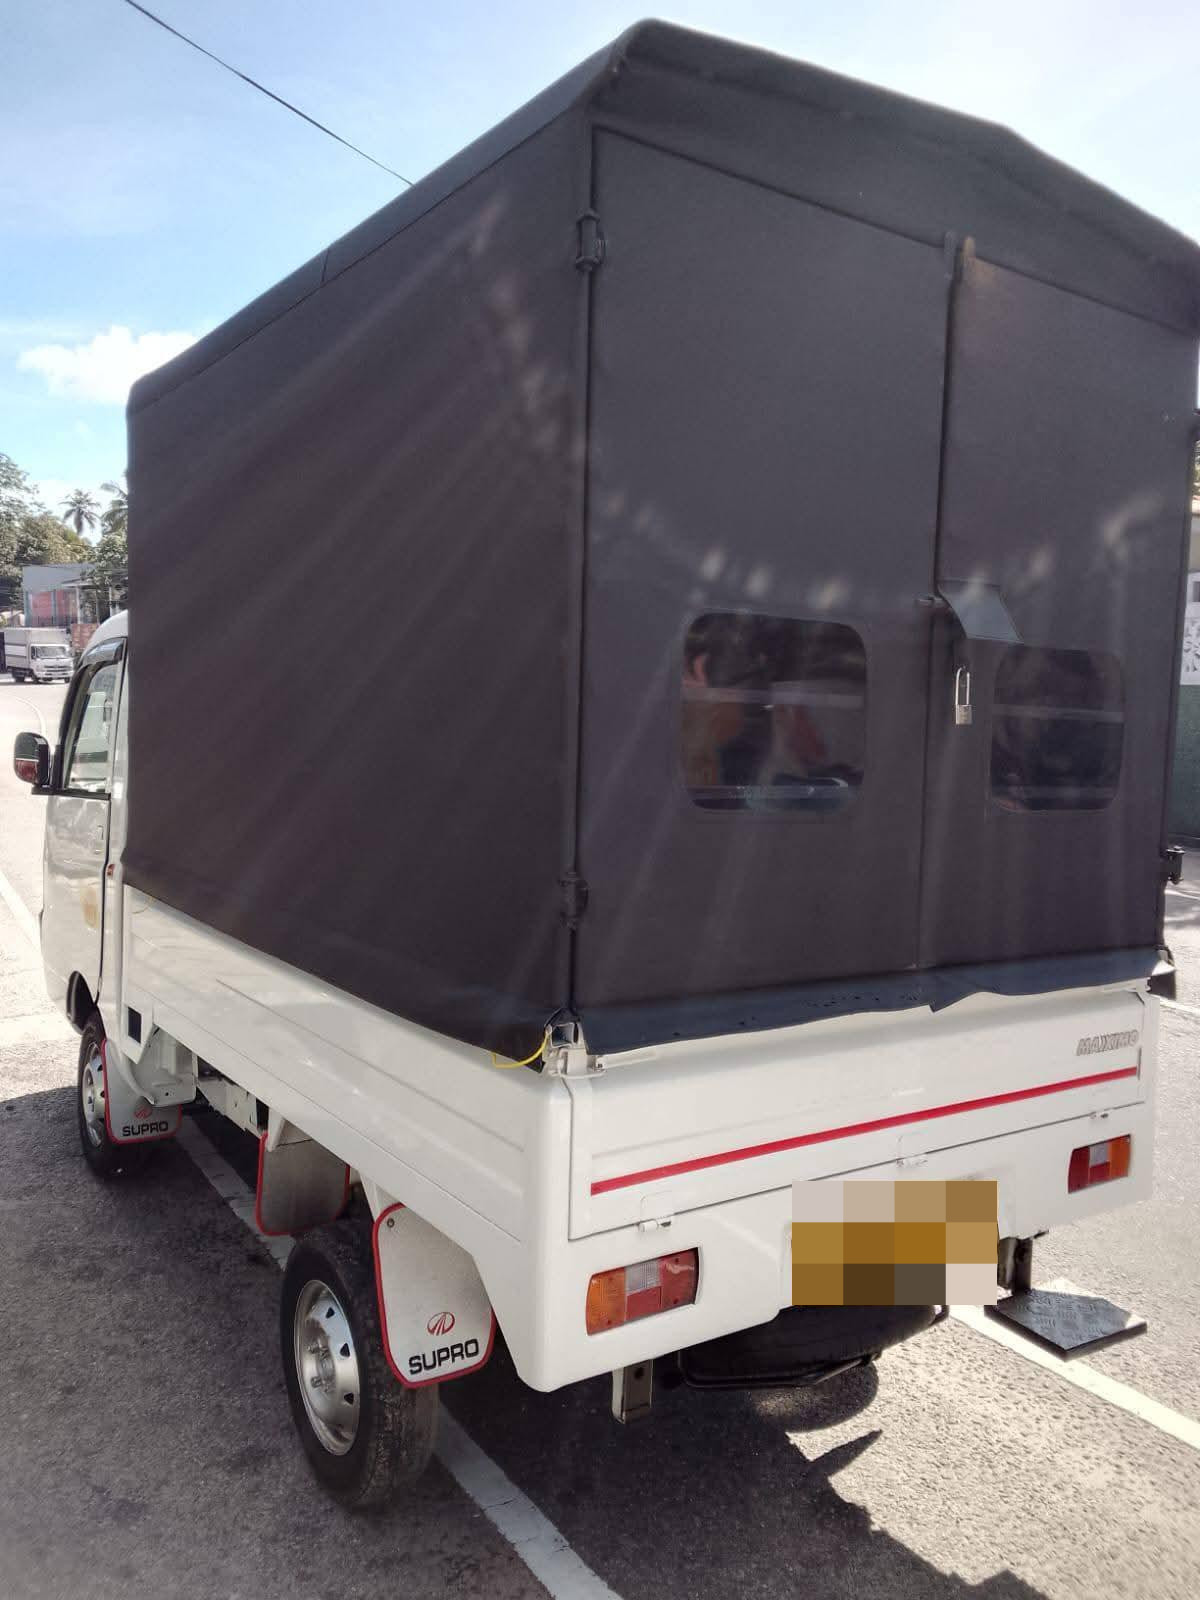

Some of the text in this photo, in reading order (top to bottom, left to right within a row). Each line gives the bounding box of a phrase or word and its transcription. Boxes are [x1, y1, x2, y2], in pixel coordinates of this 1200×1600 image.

[1076, 1029, 1139, 1056] MAXIMO
[122, 1120, 169, 1137] SUPRO
[408, 1338, 479, 1375] SUPRO
